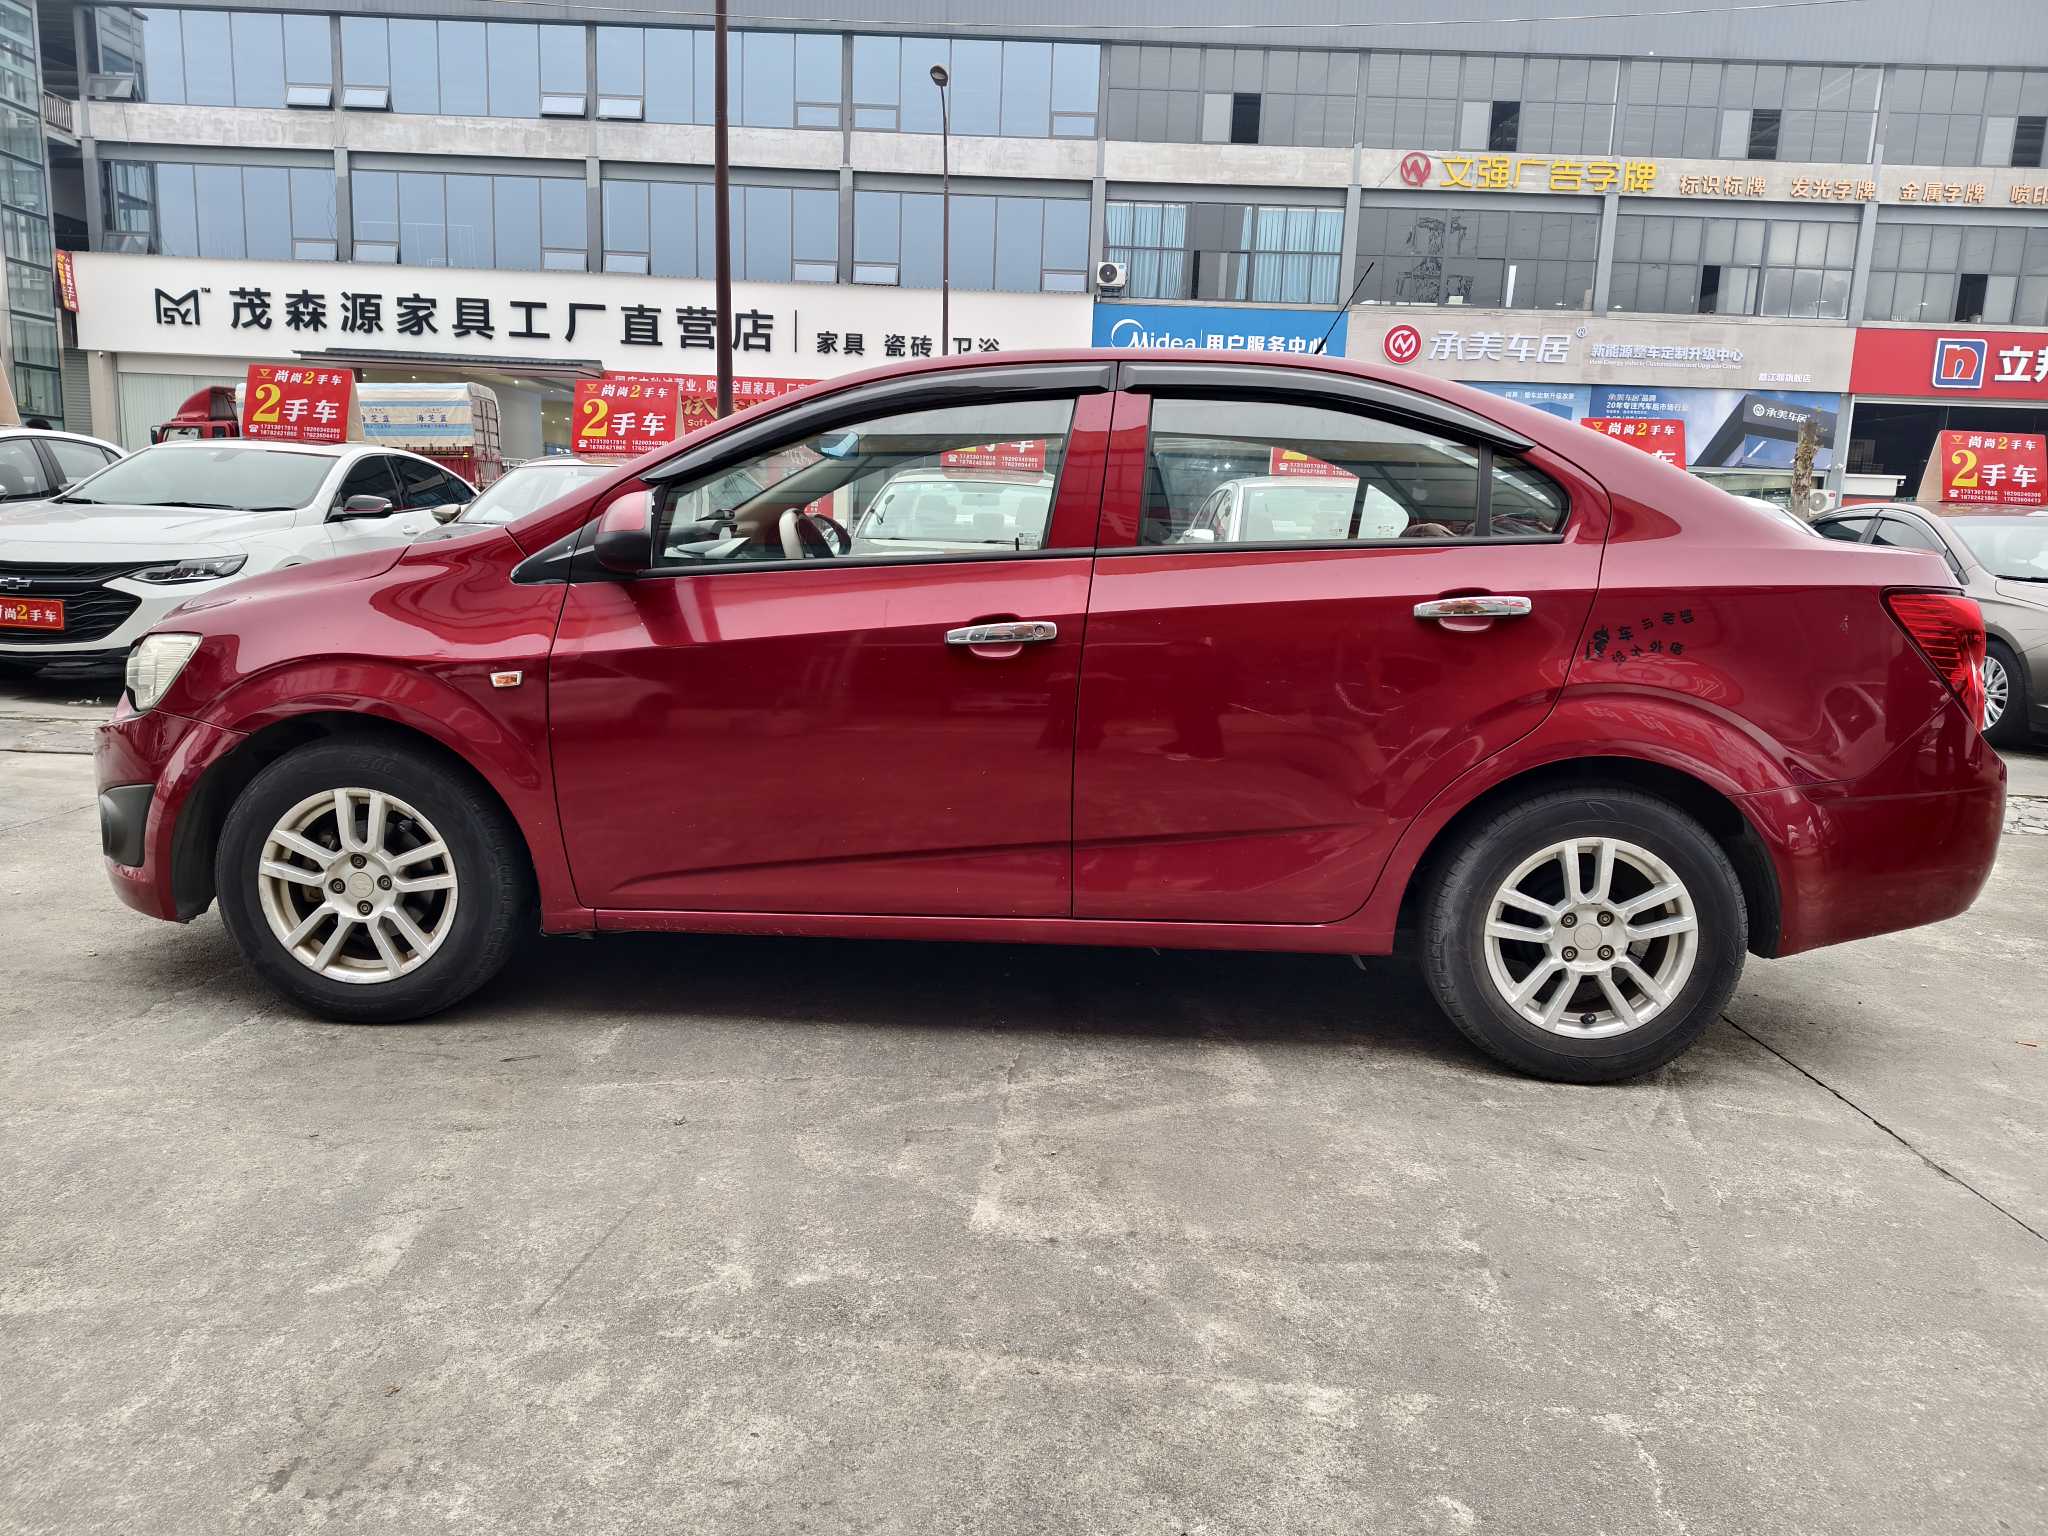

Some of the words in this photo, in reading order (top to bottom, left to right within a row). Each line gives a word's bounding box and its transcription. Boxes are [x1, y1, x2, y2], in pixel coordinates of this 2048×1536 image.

[1440, 156, 1657, 193] 文强广告字牌
[1679, 175, 1768, 197] 标识标牌
[1791, 177, 1876, 200] 发光字牌
[1899, 181, 1985, 203] 金属字牌
[229, 287, 774, 352] 茂森源家具工厂直营店
[816, 331, 865, 356] 家具
[884, 334, 933, 357] 瓷砖
[1129, 331, 1196, 349] Midea
[1206, 334, 1328, 355] 用户服务中心
[1428, 330, 1572, 363] 承美车居
[274, 369, 342, 386] 尚尚2手车
[601, 383, 668, 398] 尚尚2手车
[252, 383, 339, 424] 2手车
[581, 398, 667, 437] 2手车
[1607, 422, 1676, 436] 尚尚2手车
[1968, 435, 2037, 450] 尚尚2手车
[1951, 449, 2038, 488] 2手车
